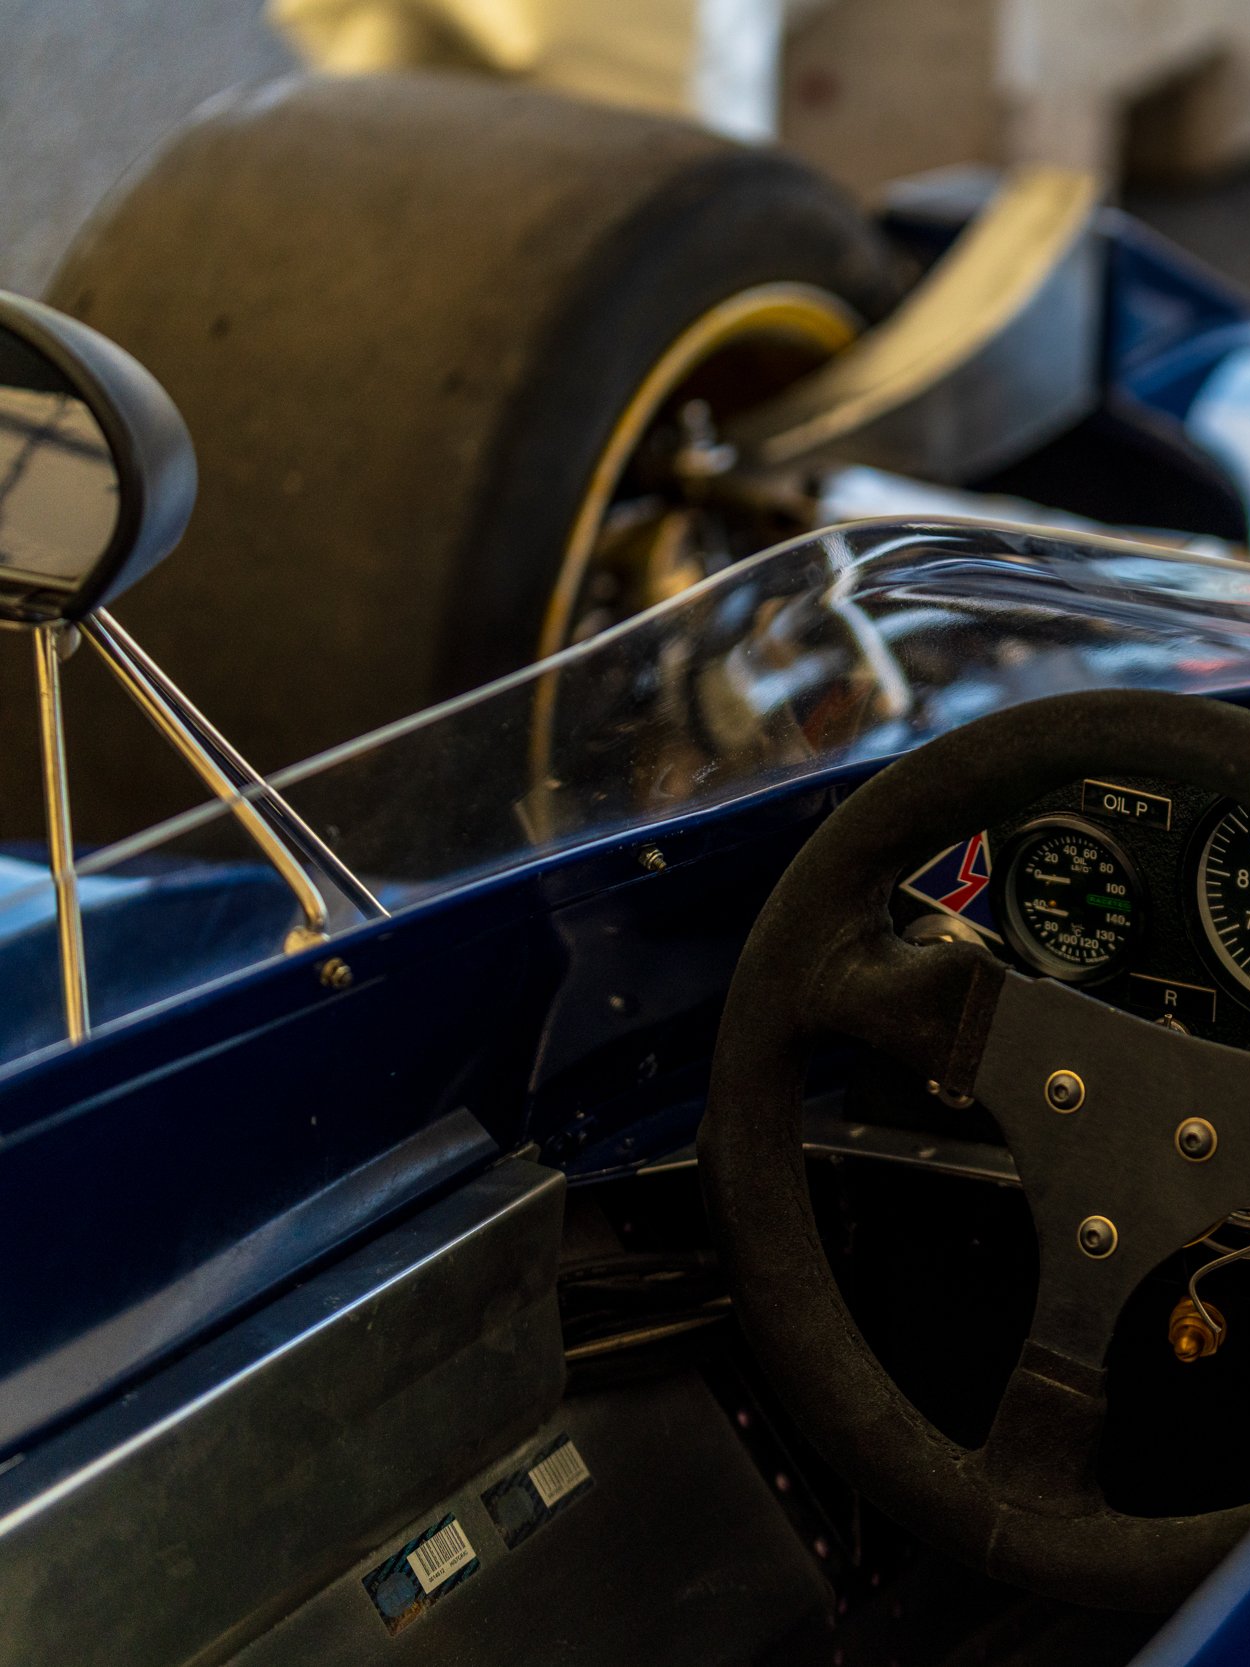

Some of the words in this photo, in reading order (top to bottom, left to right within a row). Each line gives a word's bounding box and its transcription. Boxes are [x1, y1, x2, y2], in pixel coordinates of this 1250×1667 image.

[1103, 793, 1131, 815] OIL
[1136, 801, 1148, 817] P
[1044, 852, 1059, 864] 20
[1063, 844, 1077, 856] 40
[1083, 848, 1097, 861] 60
[1099, 862, 1114, 875] 80
[1236, 868, 1250, 889] 8
[1105, 883, 1126, 896] 100
[1044, 920, 1059, 932] 80
[1059, 933, 1078, 946] 100
[1080, 936, 1099, 950] 120
[1095, 929, 1116, 942] 130
[1164, 990, 1178, 1007] R
